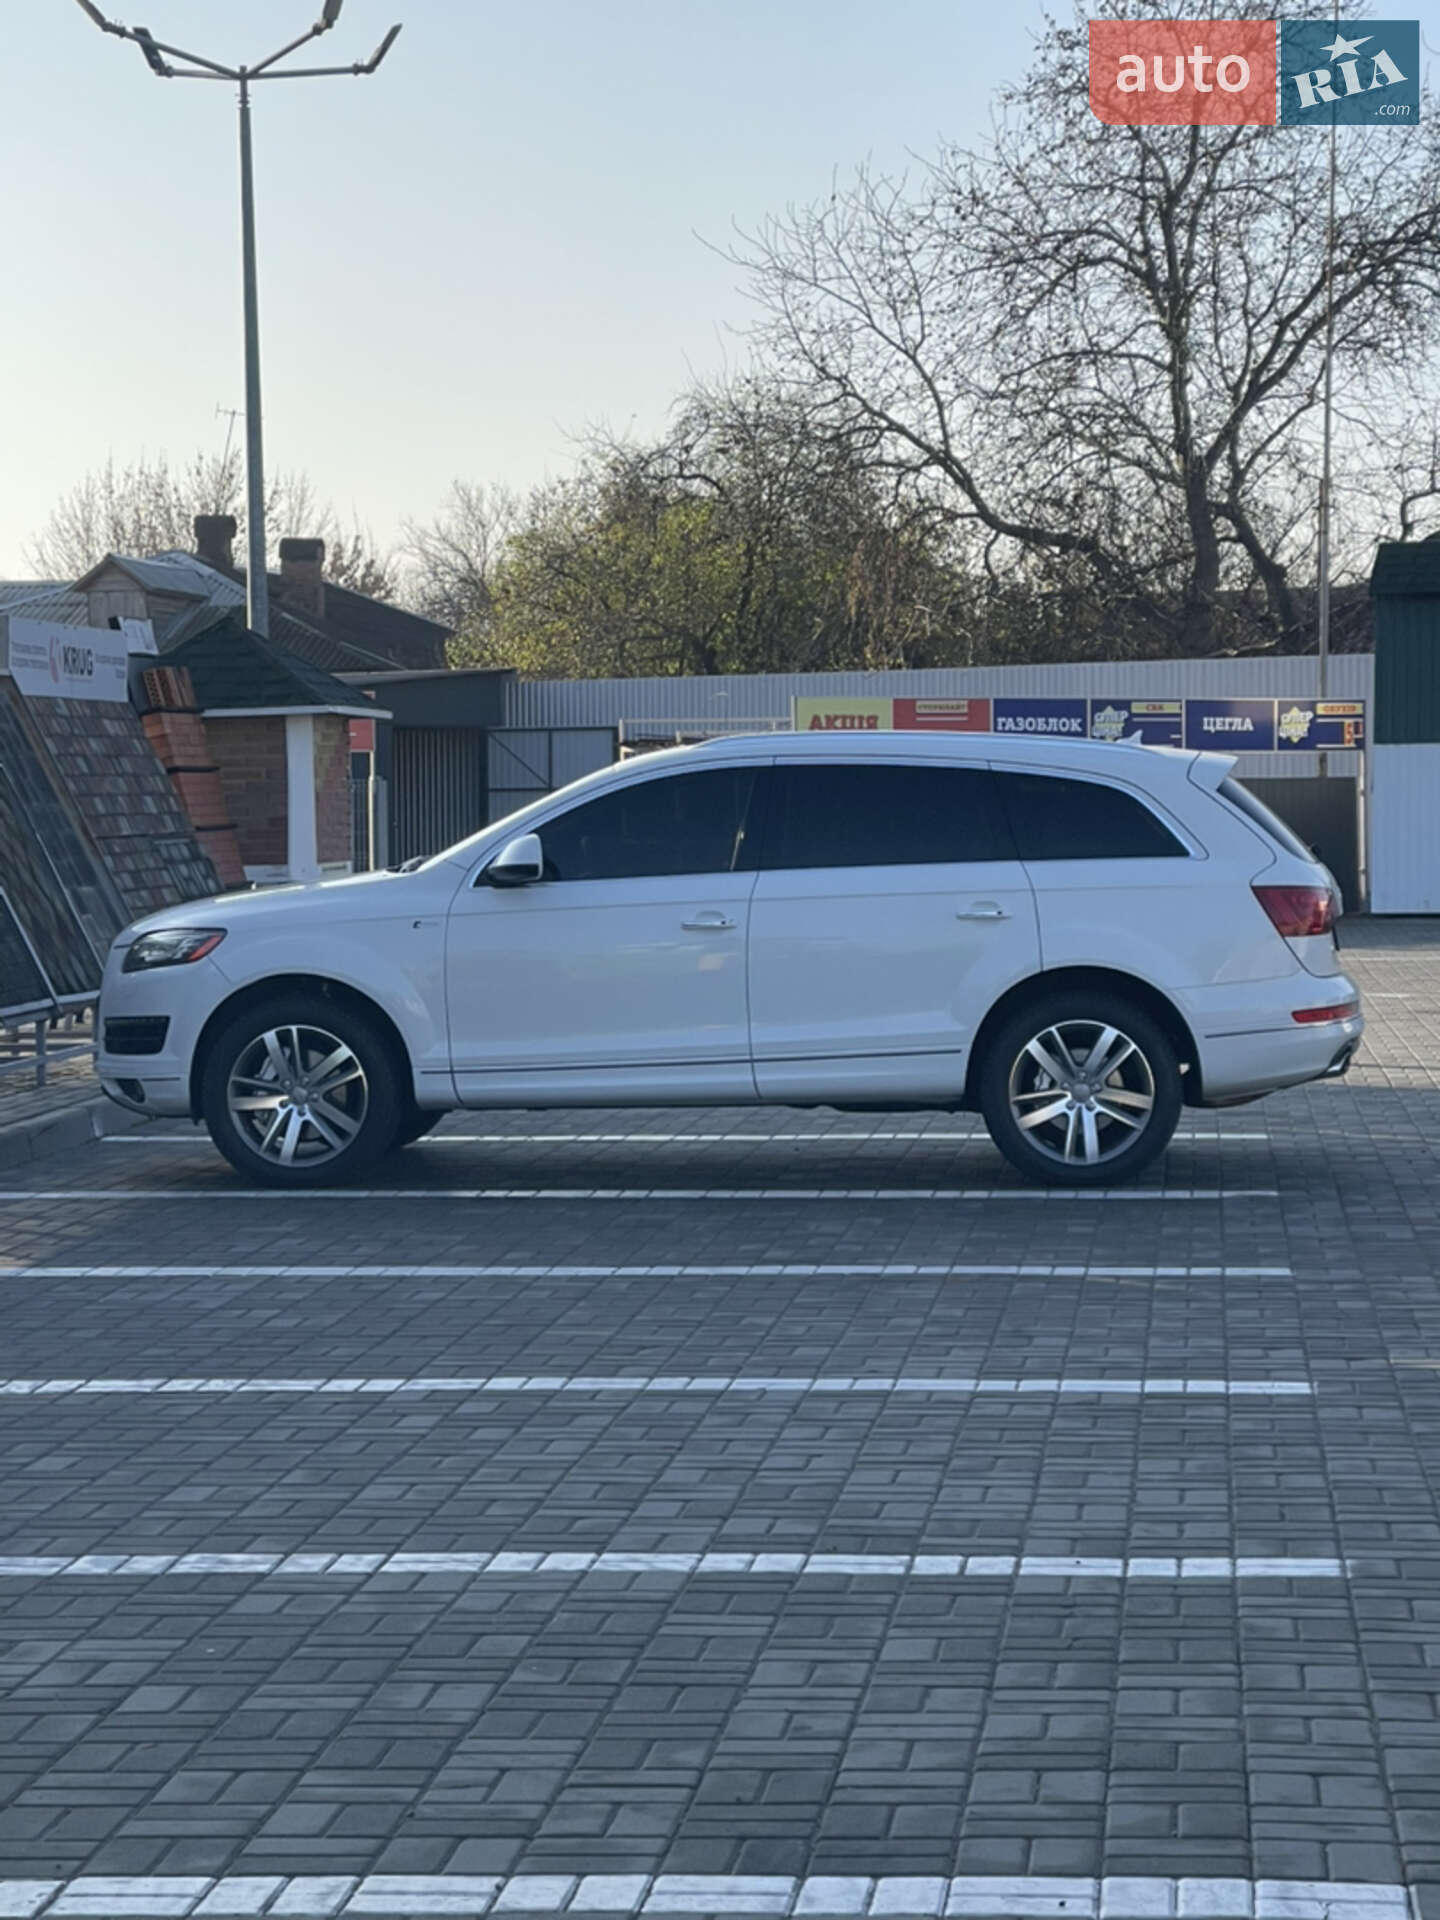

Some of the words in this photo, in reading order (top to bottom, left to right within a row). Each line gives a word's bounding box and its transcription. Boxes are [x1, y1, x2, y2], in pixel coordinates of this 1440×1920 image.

[62, 645, 94, 676] KRUG
[996, 717, 1082, 732] ГАЗОБЛОК
[1202, 717, 1254, 733] ЦЕГЛА
